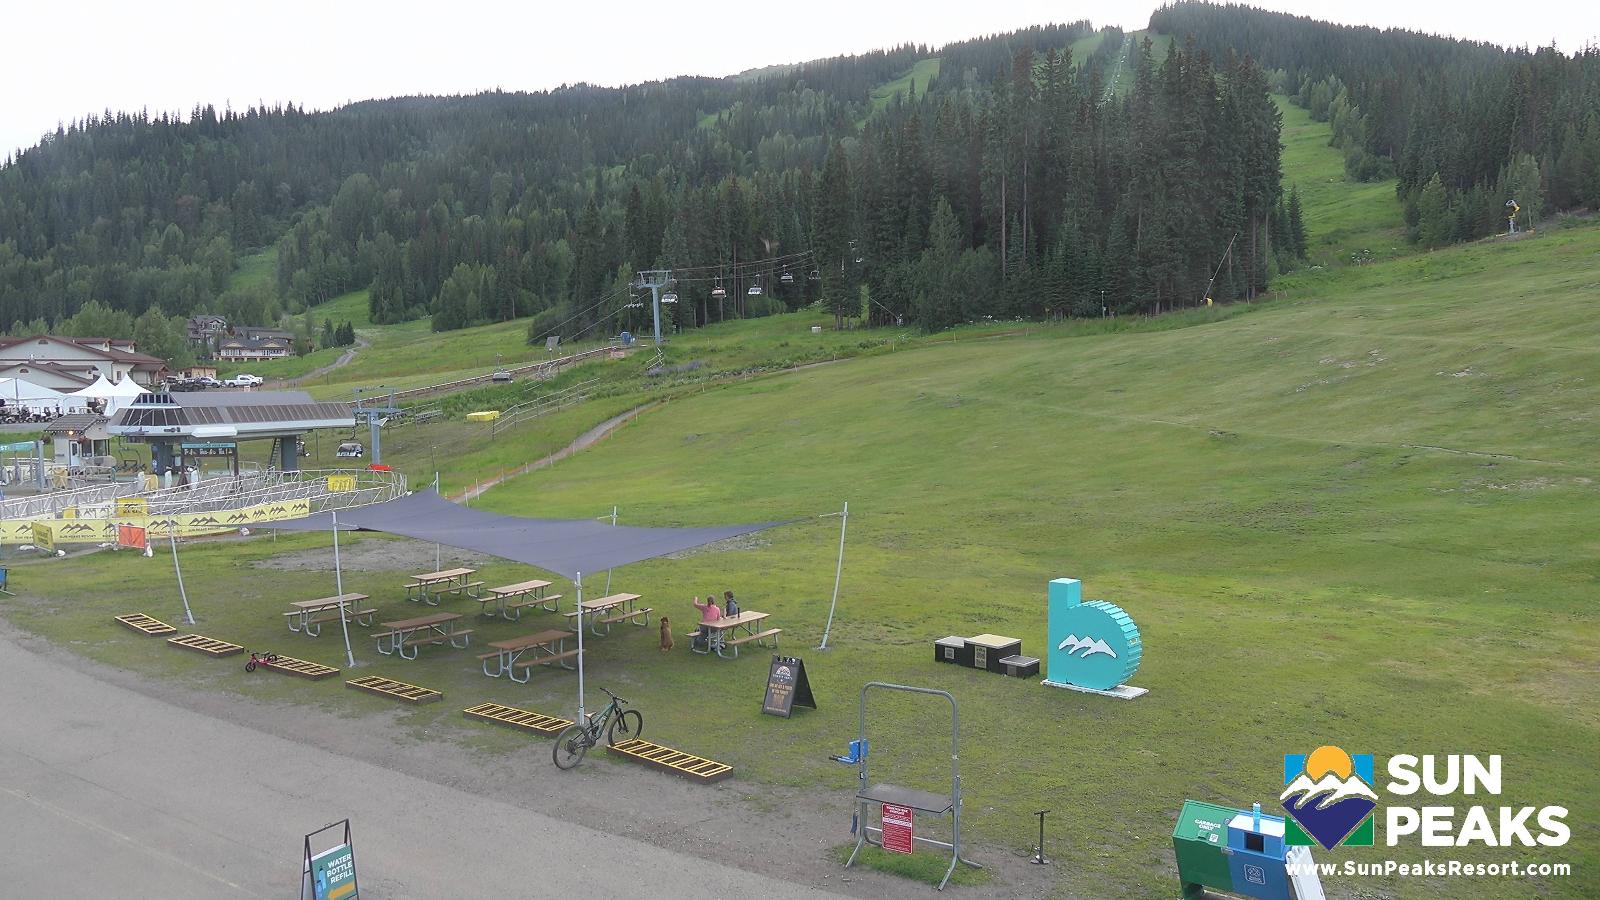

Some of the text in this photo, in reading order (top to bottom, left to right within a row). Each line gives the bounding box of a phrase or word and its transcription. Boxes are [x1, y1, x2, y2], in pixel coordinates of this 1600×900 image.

[328, 854, 351, 867] WATER
[327, 861, 352, 877] BOTTLE
[330, 870, 353, 884] REFILL
